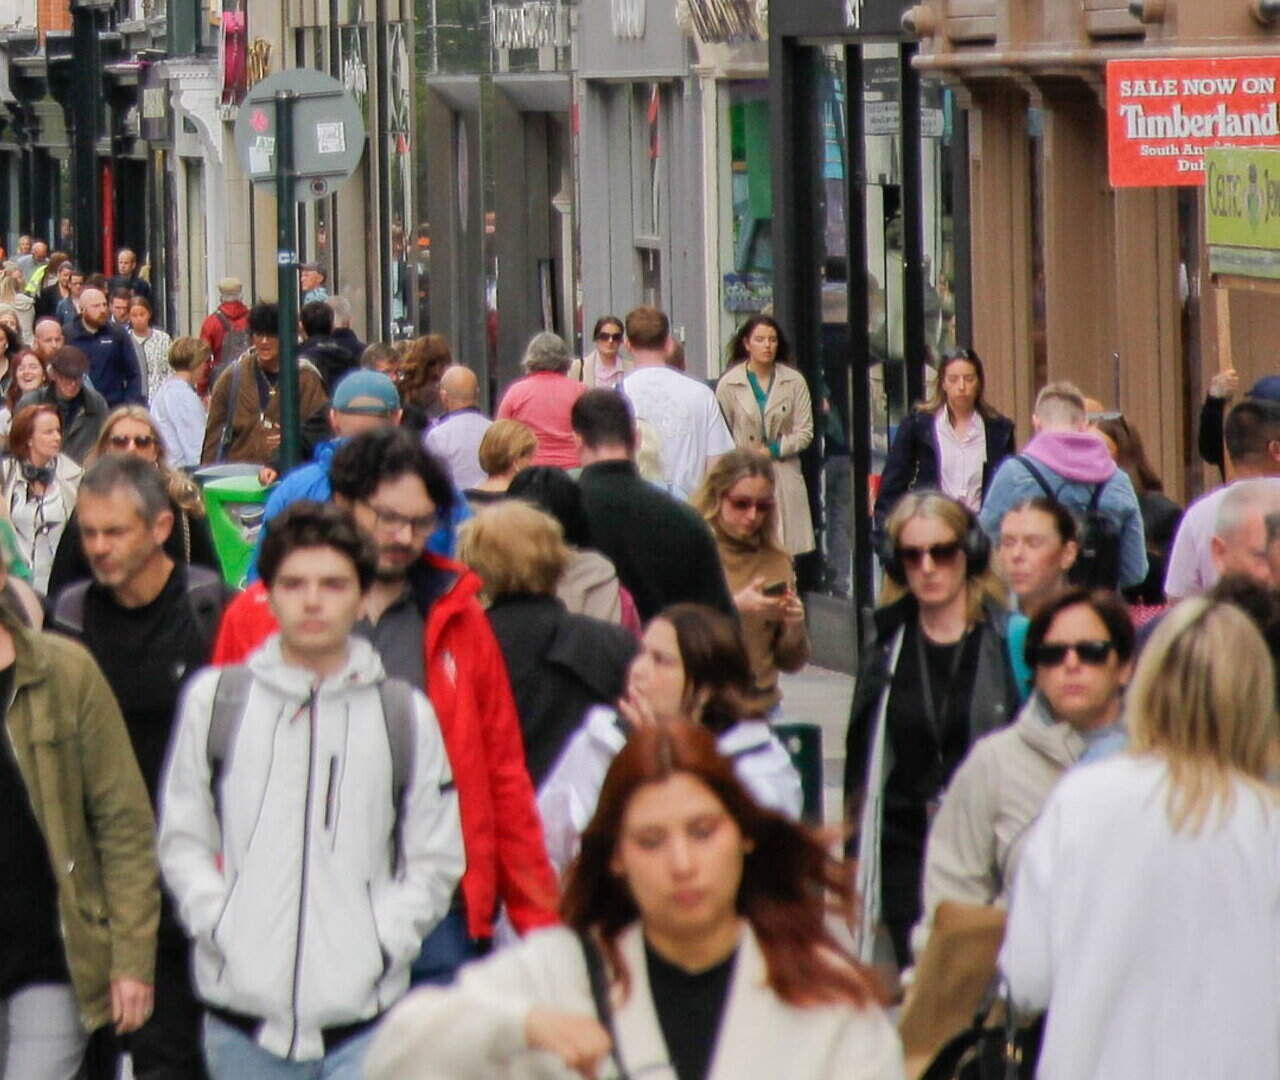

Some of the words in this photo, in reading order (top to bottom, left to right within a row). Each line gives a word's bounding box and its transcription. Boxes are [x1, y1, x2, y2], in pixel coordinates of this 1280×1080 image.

[1120, 79, 1178, 97] SALE
[1182, 78, 1237, 96] NOW
[1242, 77, 1276, 94] ON
[1120, 102, 1280, 139] Timberland
[1141, 145, 1179, 156] South
[1183, 145, 1205, 155] An
